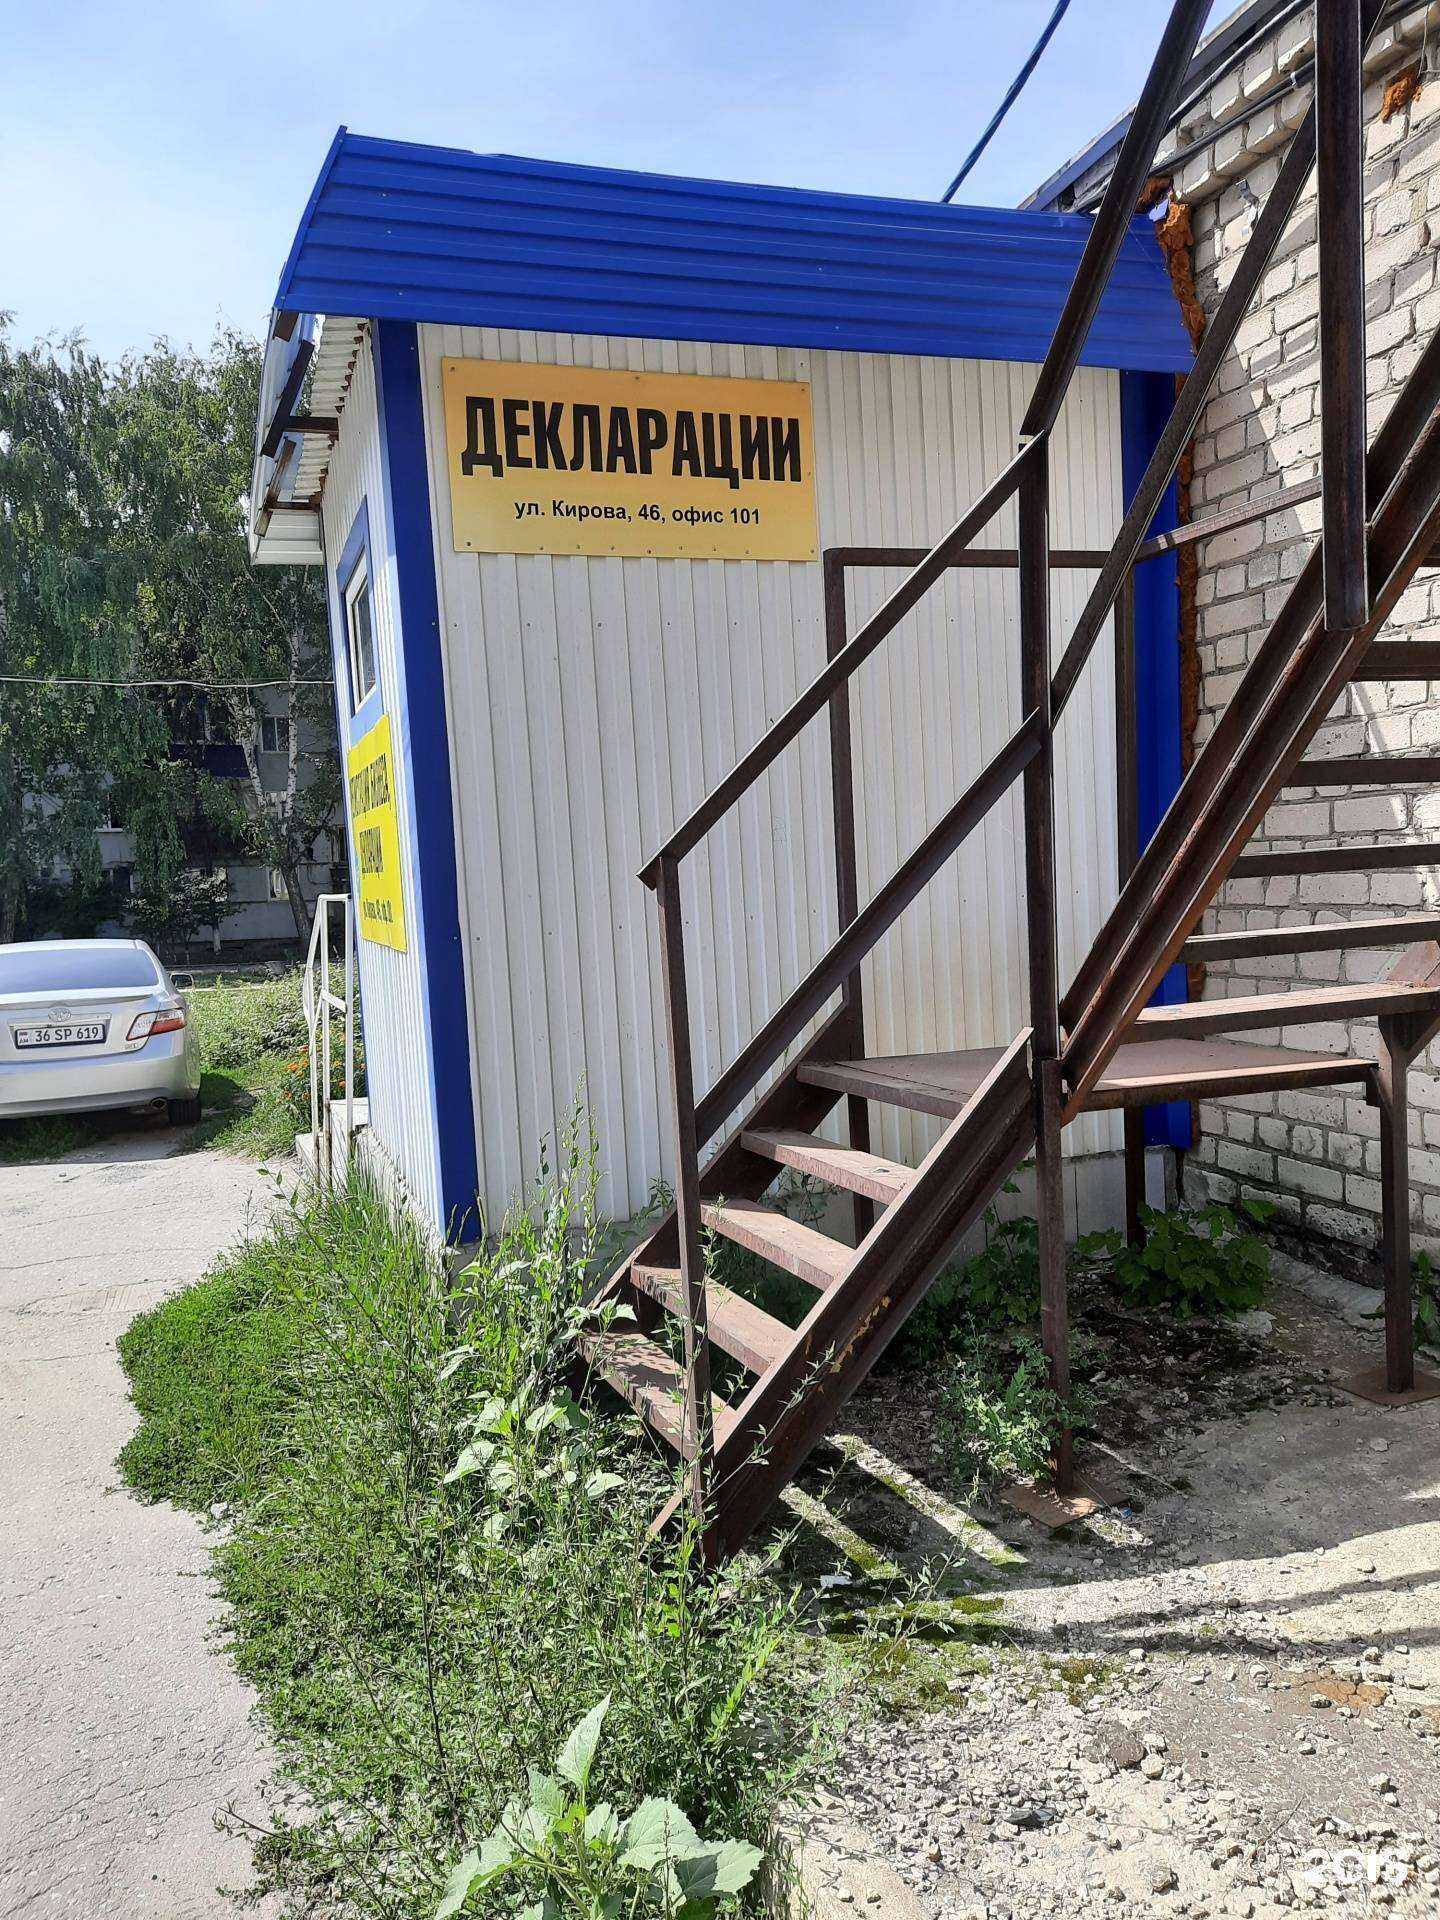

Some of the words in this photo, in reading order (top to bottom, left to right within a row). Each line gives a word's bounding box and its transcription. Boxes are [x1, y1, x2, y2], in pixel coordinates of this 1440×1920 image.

[461, 396, 802, 489] ДЕКЛАРАЦИИ
[514, 500, 546, 521] ул.
[552, 500, 633, 523] Кирова,
[638, 503, 666, 524] 46,
[672, 506, 724, 526] офис
[730, 507, 761, 525] 101
[35, 1030, 51, 1042] 36
[54, 1028, 72, 1041] SP
[76, 1026, 99, 1039] 619
